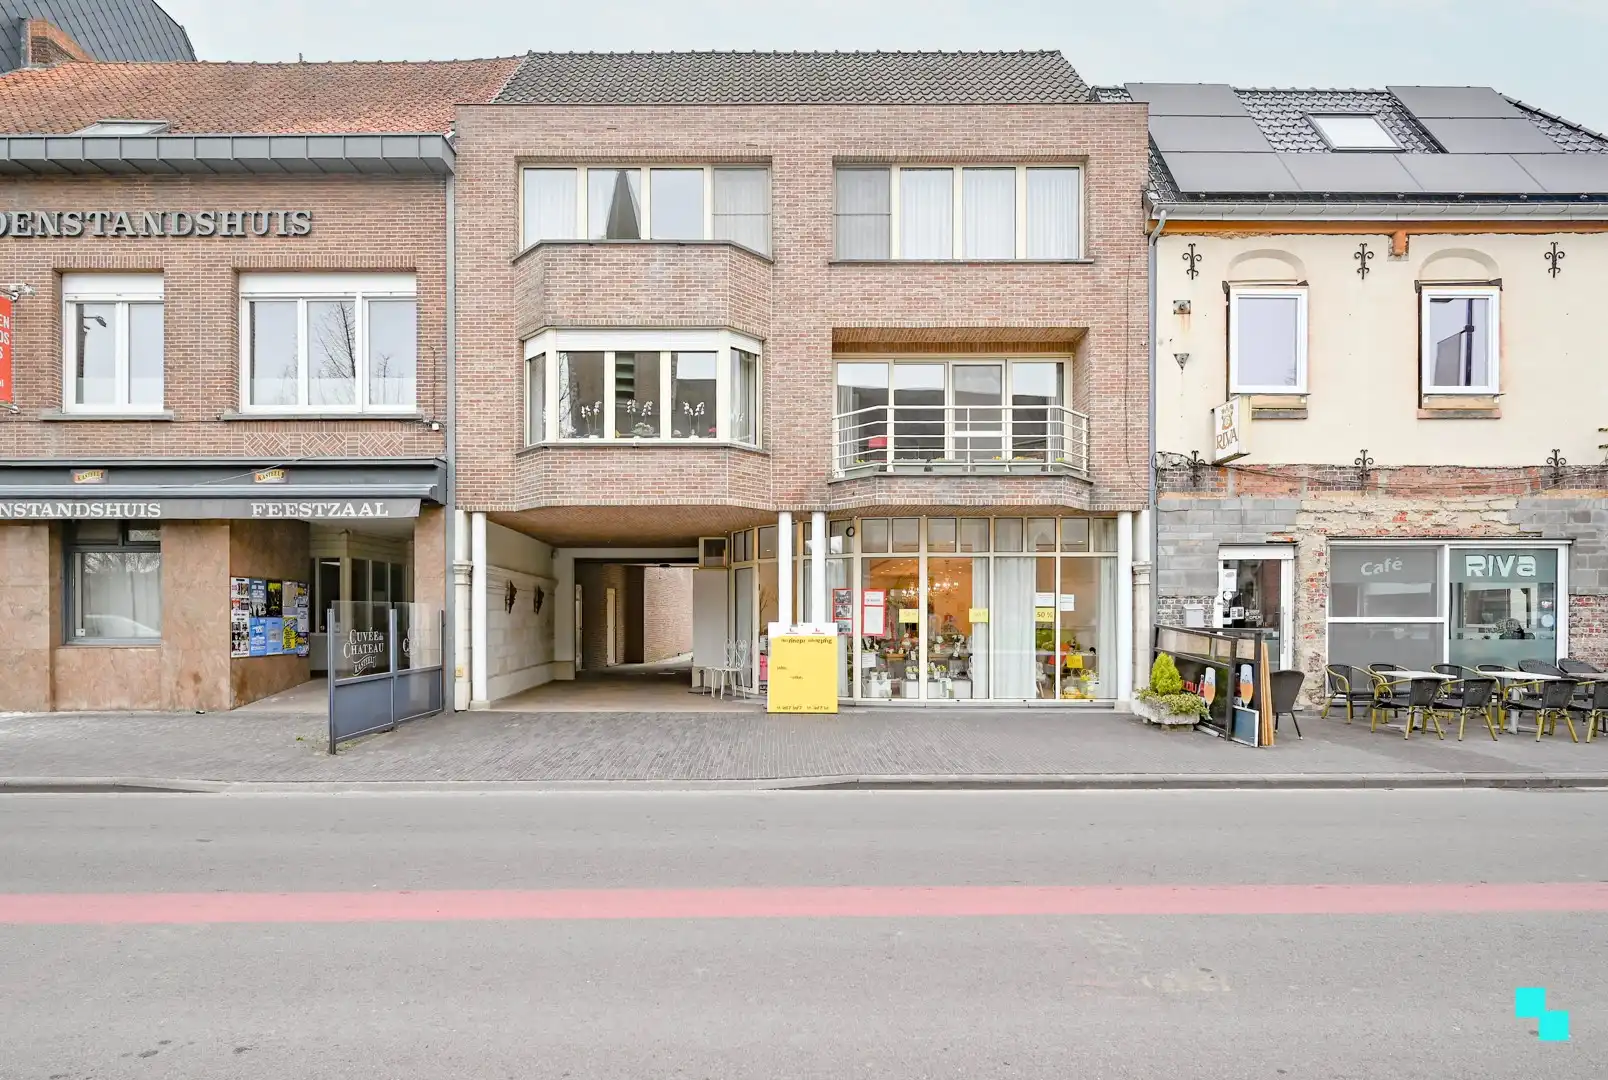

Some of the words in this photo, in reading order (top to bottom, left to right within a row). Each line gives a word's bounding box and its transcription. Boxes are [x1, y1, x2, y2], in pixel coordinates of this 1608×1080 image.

[1216, 427, 1239, 450] RIVA
[250, 502, 389, 518] FEESTZAAL
[1360, 556, 1403, 576] Café
[349, 626, 379, 645] CUVÉE
[343, 641, 385, 659] CHATEAU
